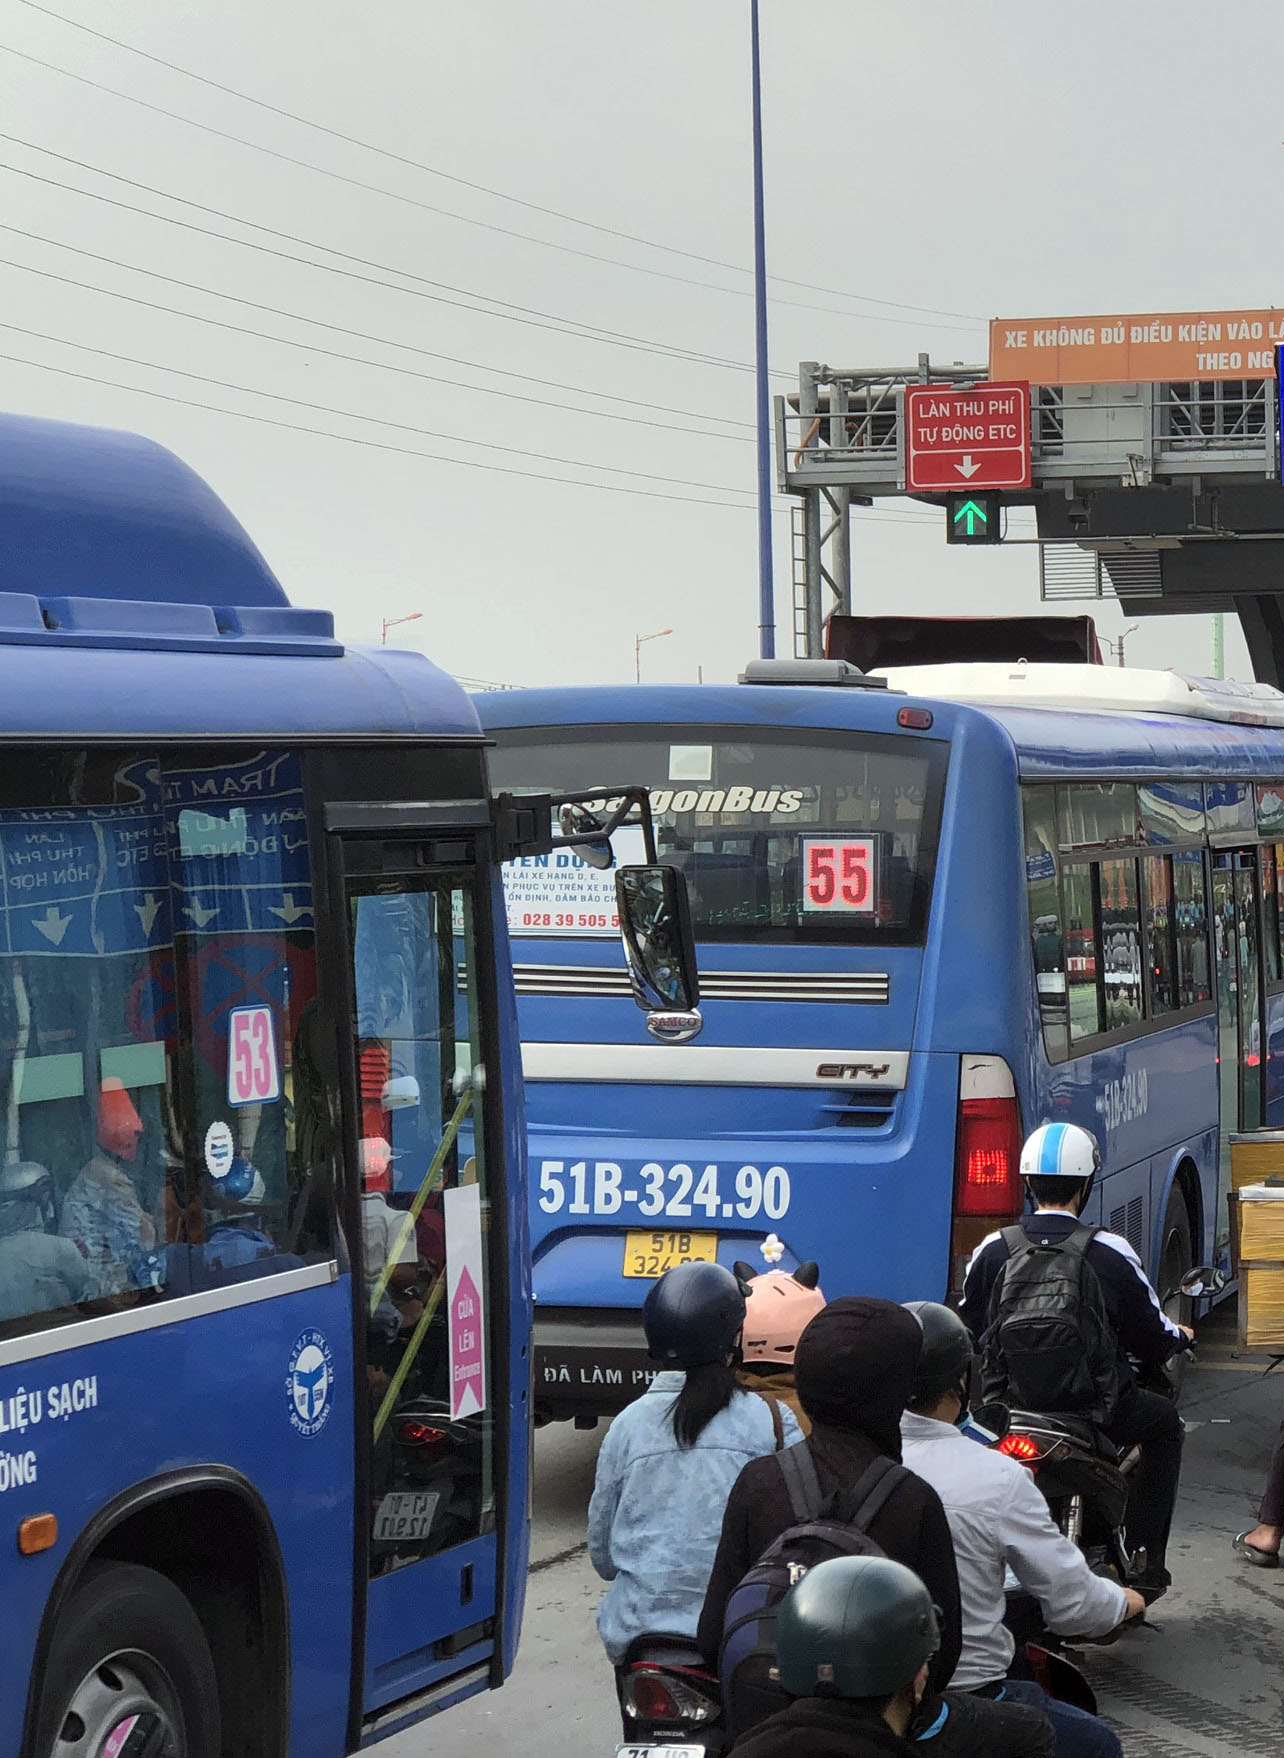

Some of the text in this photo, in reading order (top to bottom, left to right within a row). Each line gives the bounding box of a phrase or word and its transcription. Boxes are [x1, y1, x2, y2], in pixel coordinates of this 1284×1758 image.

[1004, 330, 1028, 348] XE
[1033, 325, 1095, 347] KHÔNG
[1100, 321, 1125, 344] ĐỦ
[1131, 319, 1173, 343] ĐIỀU
[1178, 321, 1221, 345] KIỆN
[1227, 319, 1262, 340] VÀO
[1196, 351, 1242, 370] THEO
[1247, 351, 1274, 370] NG
[919, 395, 1015, 418] LÀN THU PHÍ
[917, 423, 1017, 445] TỰ ĐỘNG ETC
[532, 872, 544, 880] XE
[809, 846, 870, 906] 55
[587, 884, 599, 892] XE
[523, 913, 550, 926] 028
[555, 914, 574, 926] 39
[578, 914, 606, 927] 505
[650, 1016, 698, 1027] SAMCO
[233, 1011, 272, 1100] 53
[816, 1063, 891, 1080] CITY
[538, 1160, 791, 1220] 51B-324.90
[651, 1233, 691, 1254] 51B
[544, 1364, 571, 1382] ĐÃ
[580, 1364, 623, 1384] LÀM
[0, 1375, 98, 1434] LIỆU SẠCH
